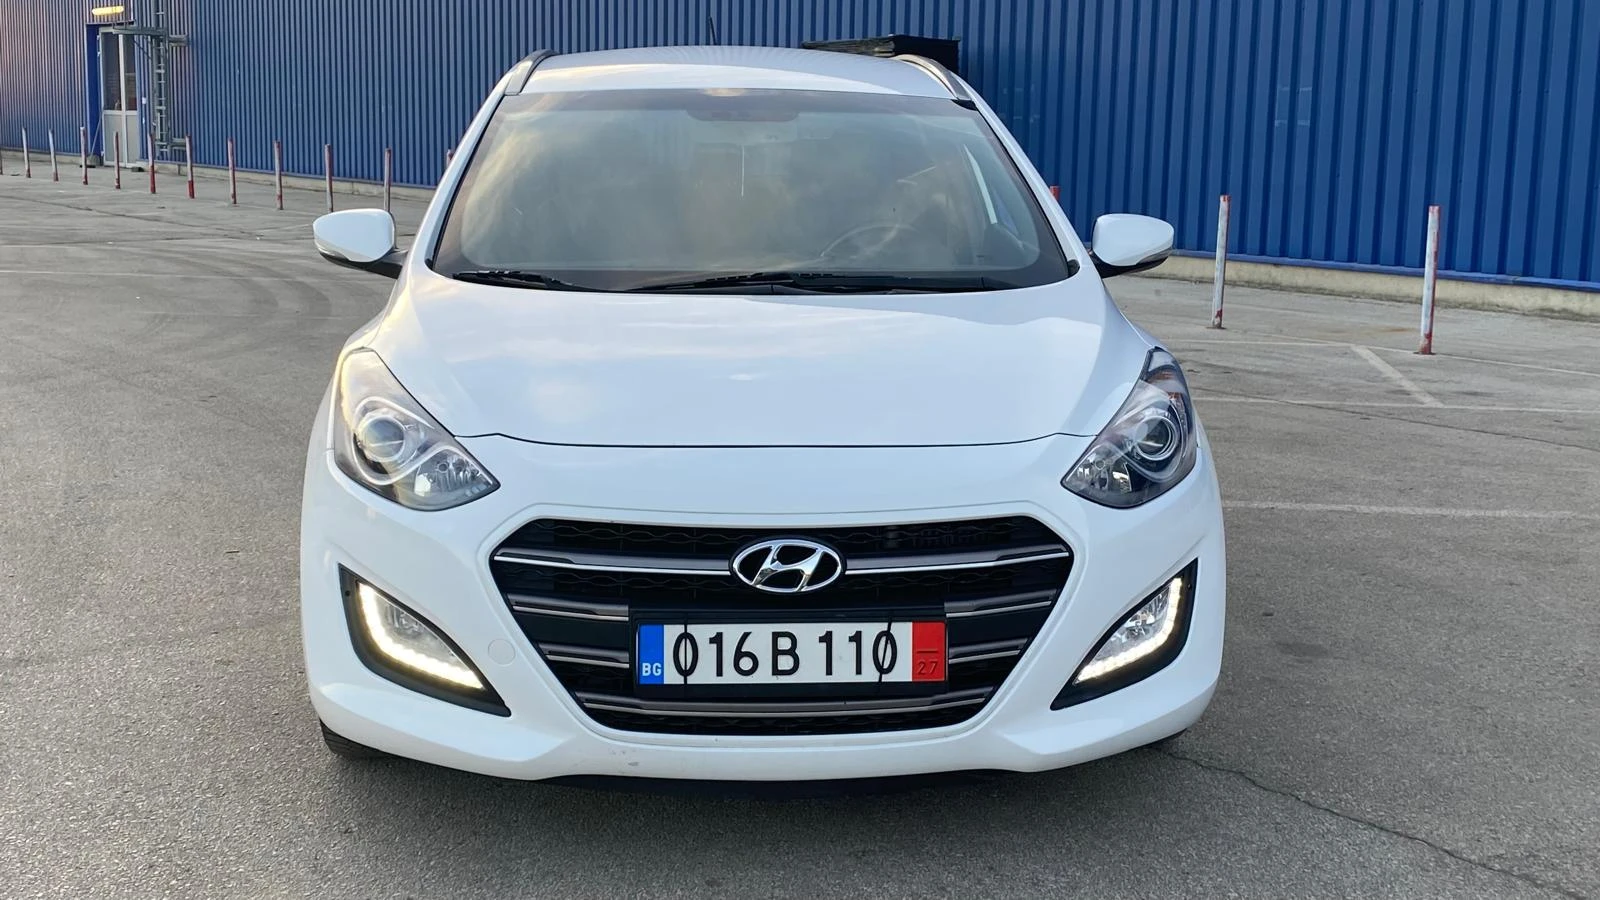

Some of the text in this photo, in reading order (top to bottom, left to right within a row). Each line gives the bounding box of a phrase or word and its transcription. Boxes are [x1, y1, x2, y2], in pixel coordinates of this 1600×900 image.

[672, 629, 898, 677] 016 B 110
[641, 662, 663, 677] BG
[917, 660, 938, 675] 27
